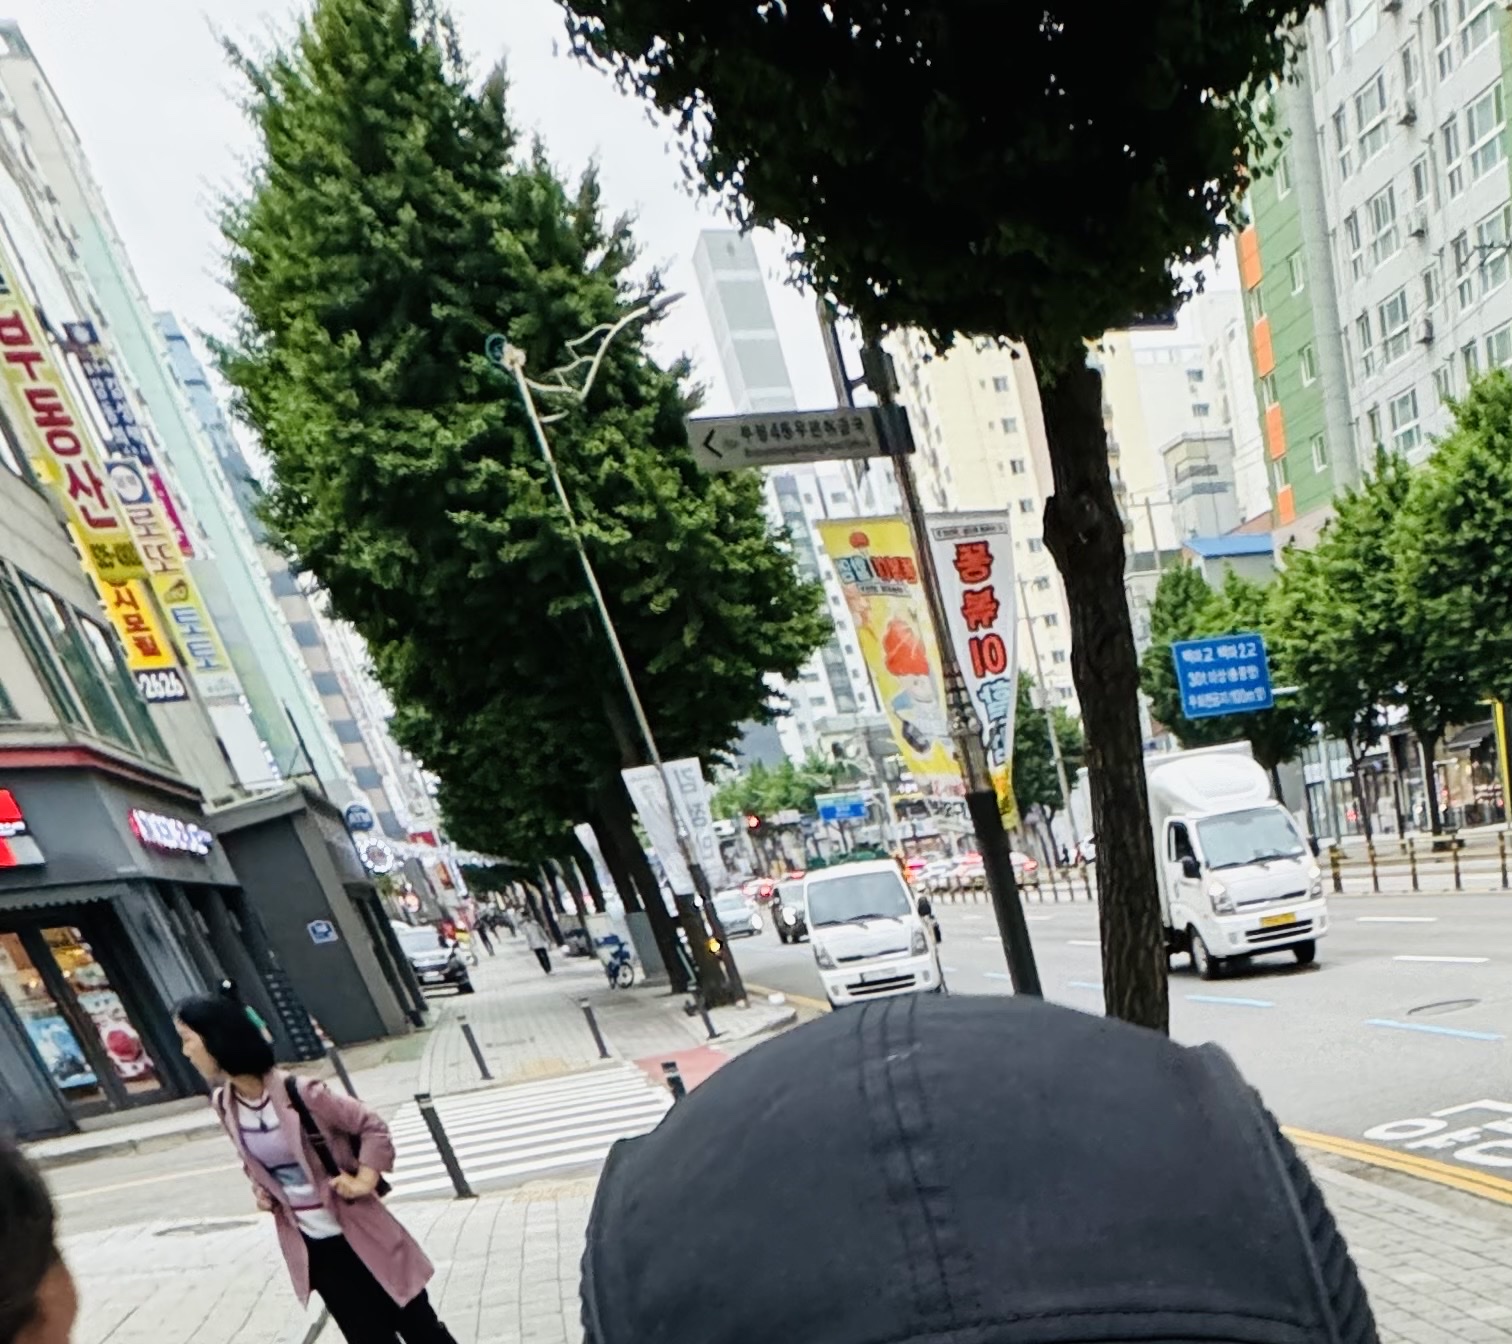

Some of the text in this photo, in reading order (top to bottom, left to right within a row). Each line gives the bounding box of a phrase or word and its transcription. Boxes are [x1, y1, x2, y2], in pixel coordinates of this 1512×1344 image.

[0, 309, 119, 529] 부동산
[128, 507, 184, 575] 로또
[171, 606, 220, 670] 토토
